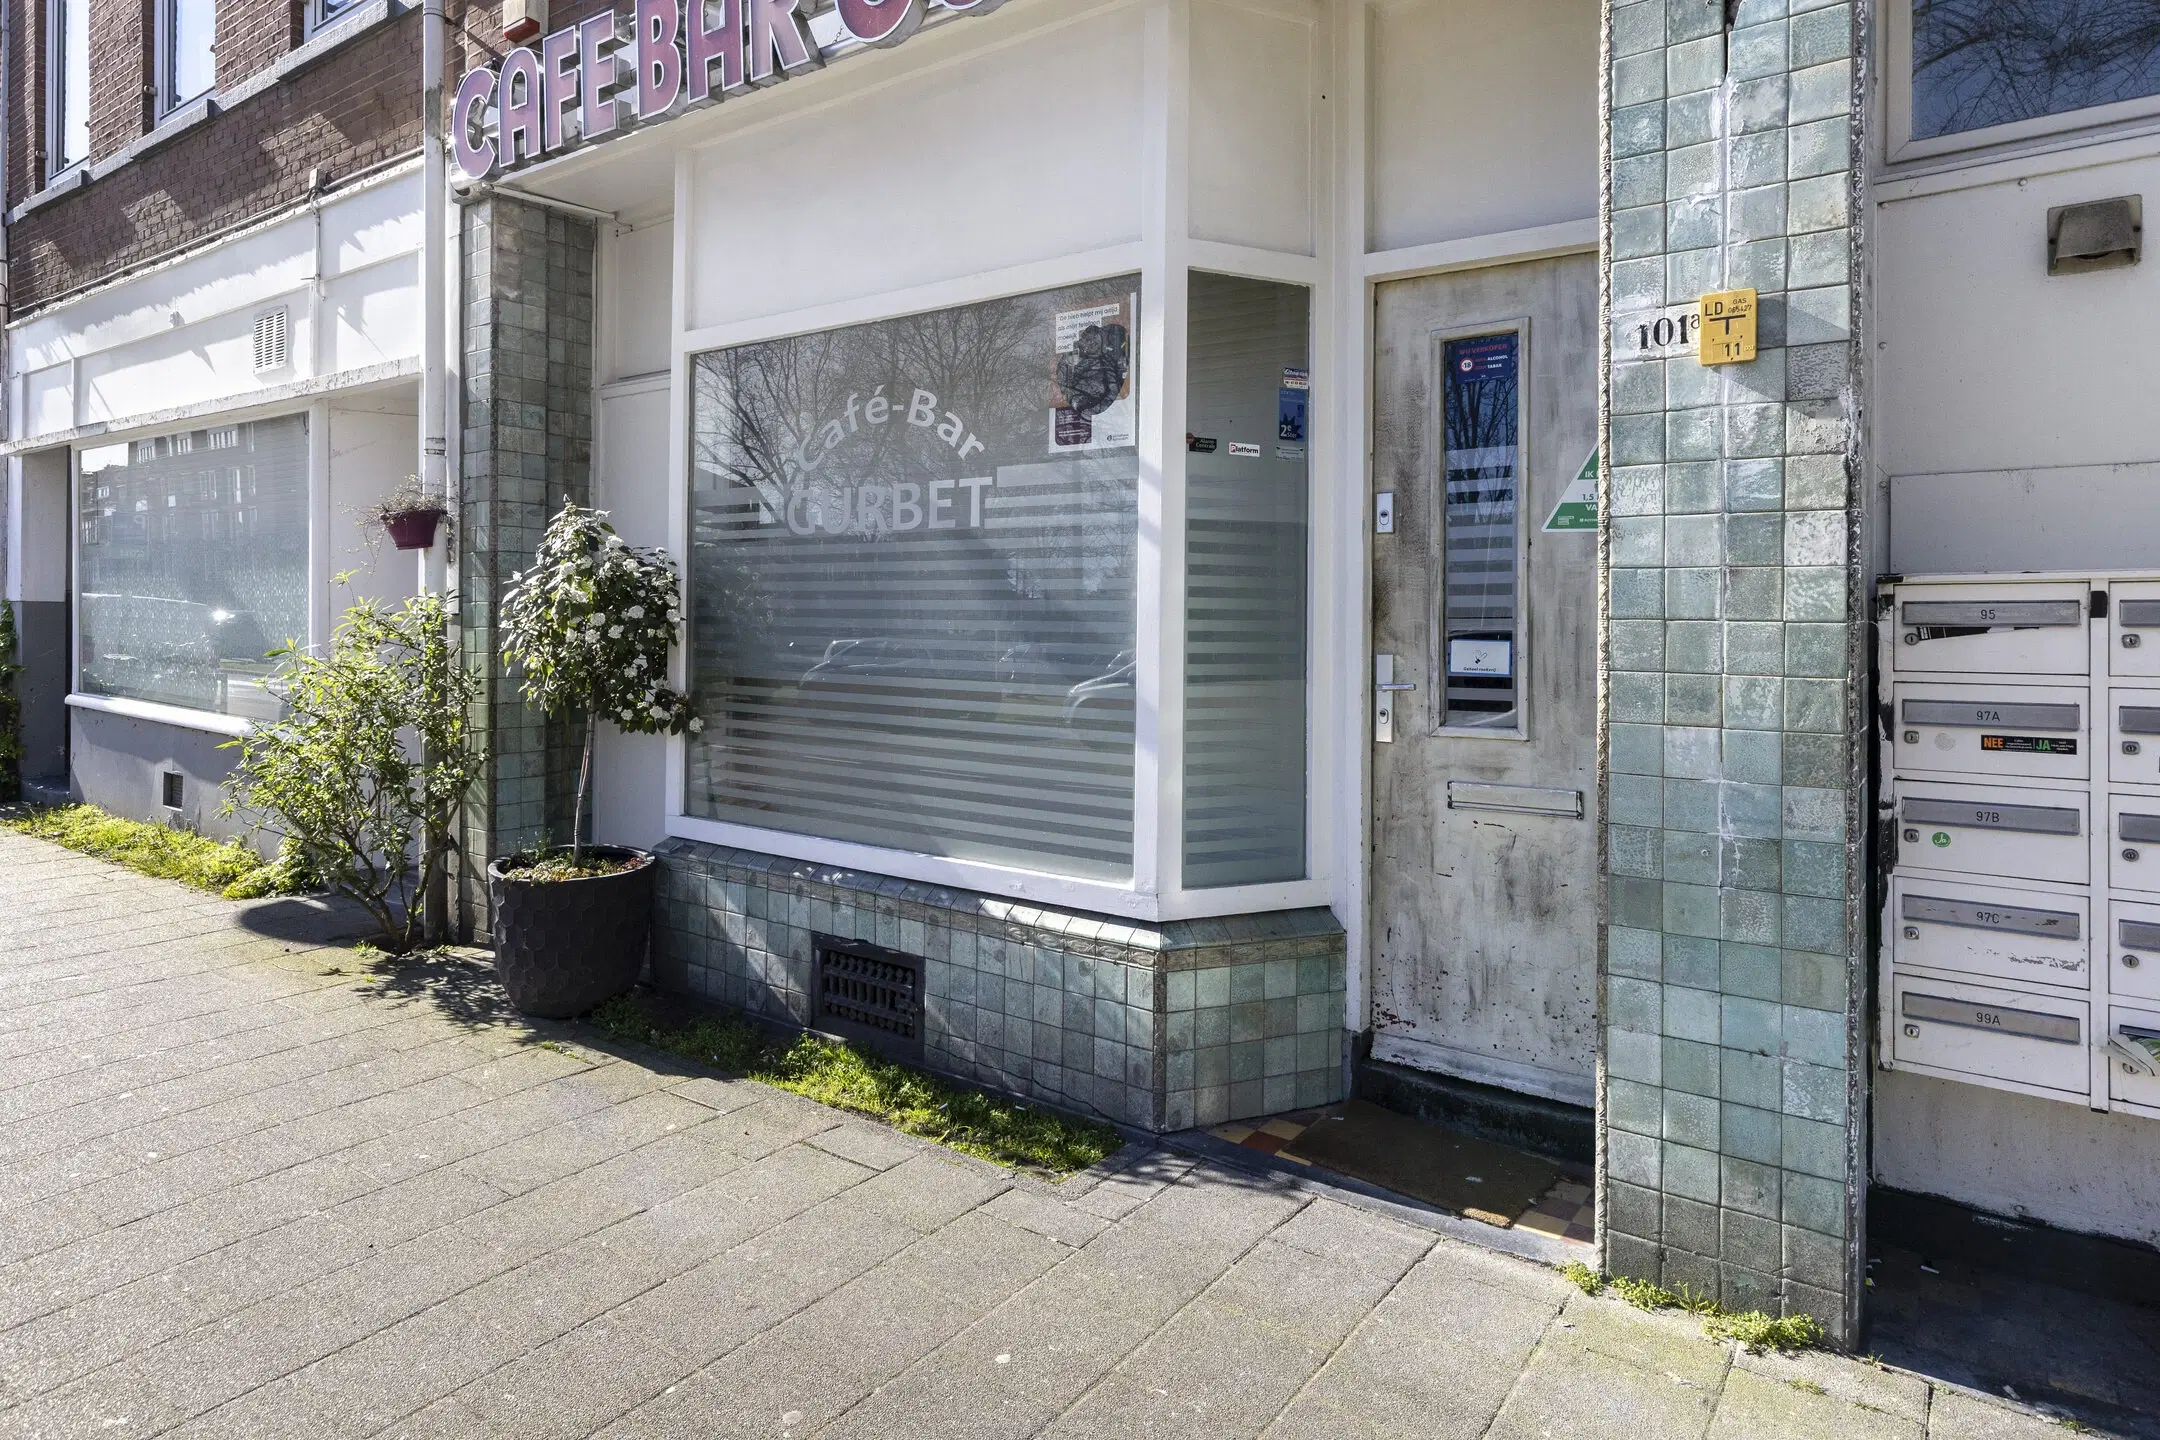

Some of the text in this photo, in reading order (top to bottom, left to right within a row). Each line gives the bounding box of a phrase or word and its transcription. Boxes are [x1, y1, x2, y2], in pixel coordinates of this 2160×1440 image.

[452, 0, 812, 181] CAFE BAR
[1704, 302, 1723, 317] LD
[1634, 313, 1700, 350] 101a
[1724, 342, 1741, 357] 11
[799, 384, 986, 473] Café-Bar
[1230, 443, 1259, 454] Platform
[1582, 494, 1594, 502] 1,5
[786, 476, 993, 536] GURBET
[1979, 609, 1997, 620] 95
[1976, 710, 2001, 722] 97A
[1983, 737, 2004, 749] NEE
[2036, 739, 2051, 751] JA
[1975, 810, 2000, 823] 97B
[1934, 833, 1948, 844] Ja
[1976, 911, 2000, 924] 97C
[1975, 1012, 2001, 1026] 99A
